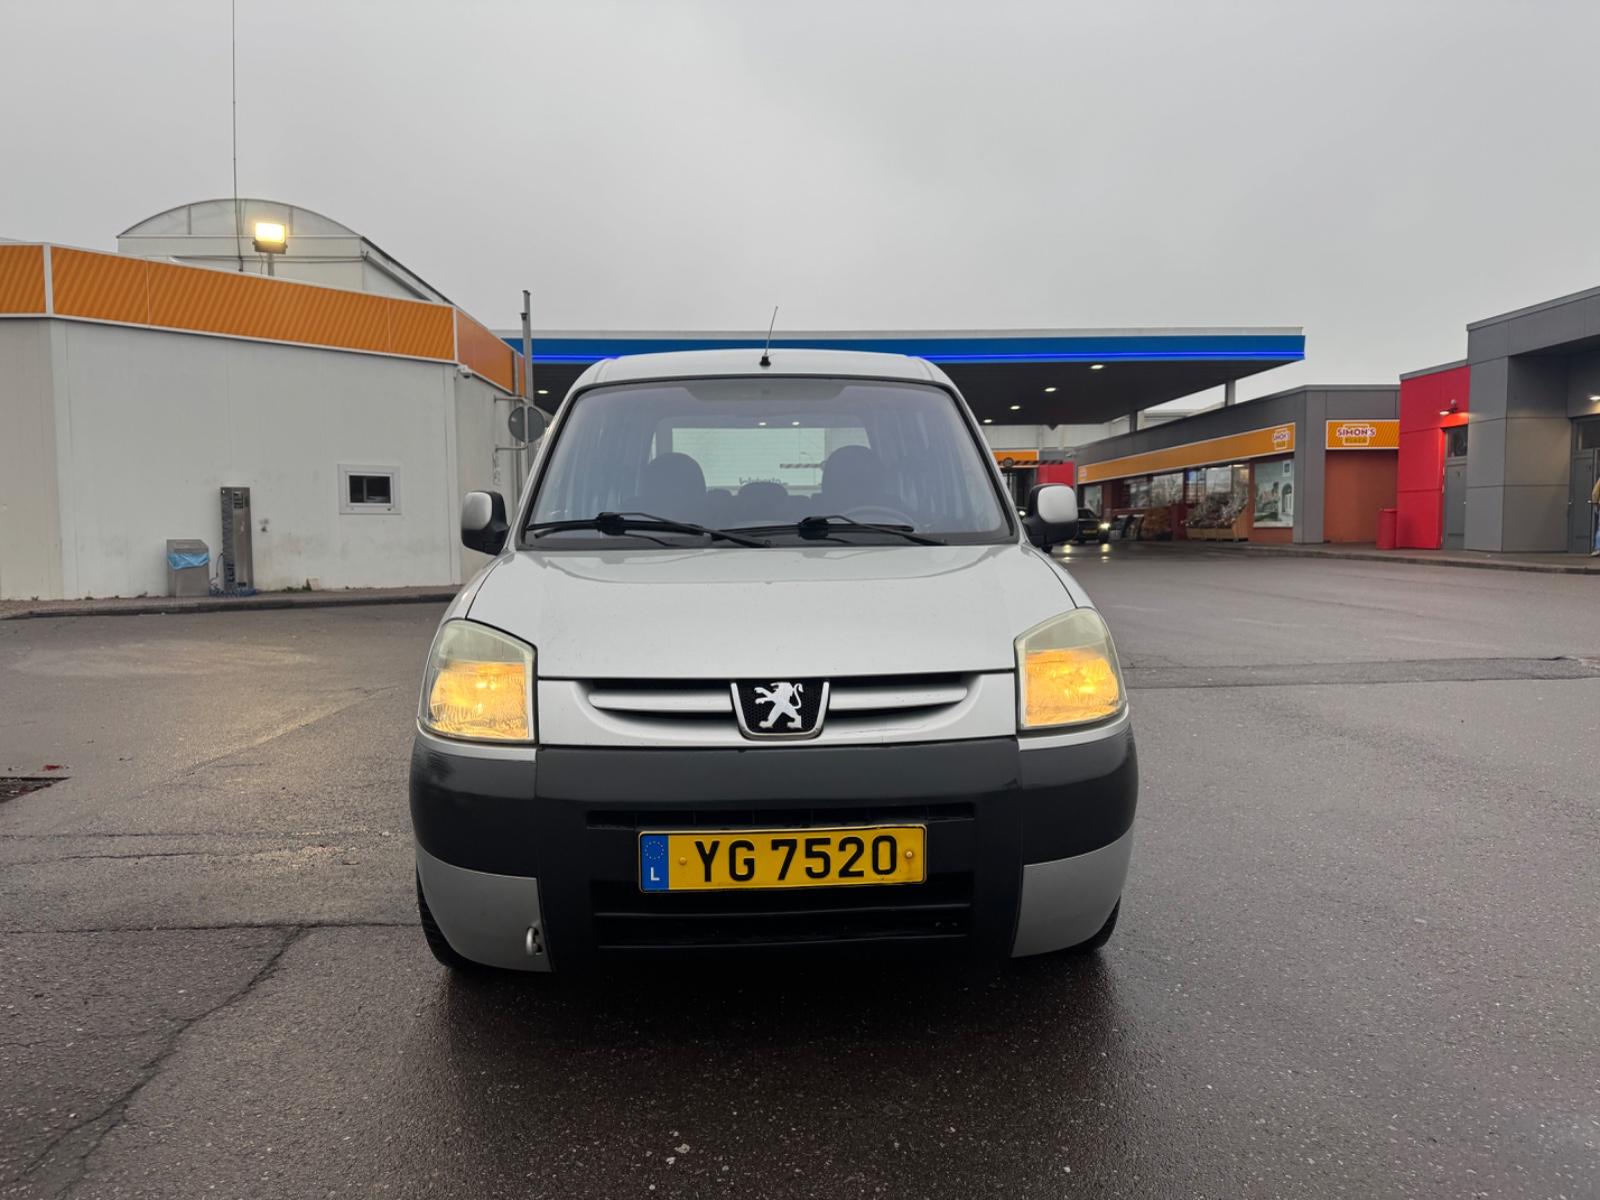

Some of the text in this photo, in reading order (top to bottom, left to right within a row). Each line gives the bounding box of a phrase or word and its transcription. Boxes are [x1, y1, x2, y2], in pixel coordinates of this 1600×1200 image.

[1337, 428, 1376, 437] SIMON'S
[694, 835, 897, 882] YG 7520
[650, 867, 660, 881] L
